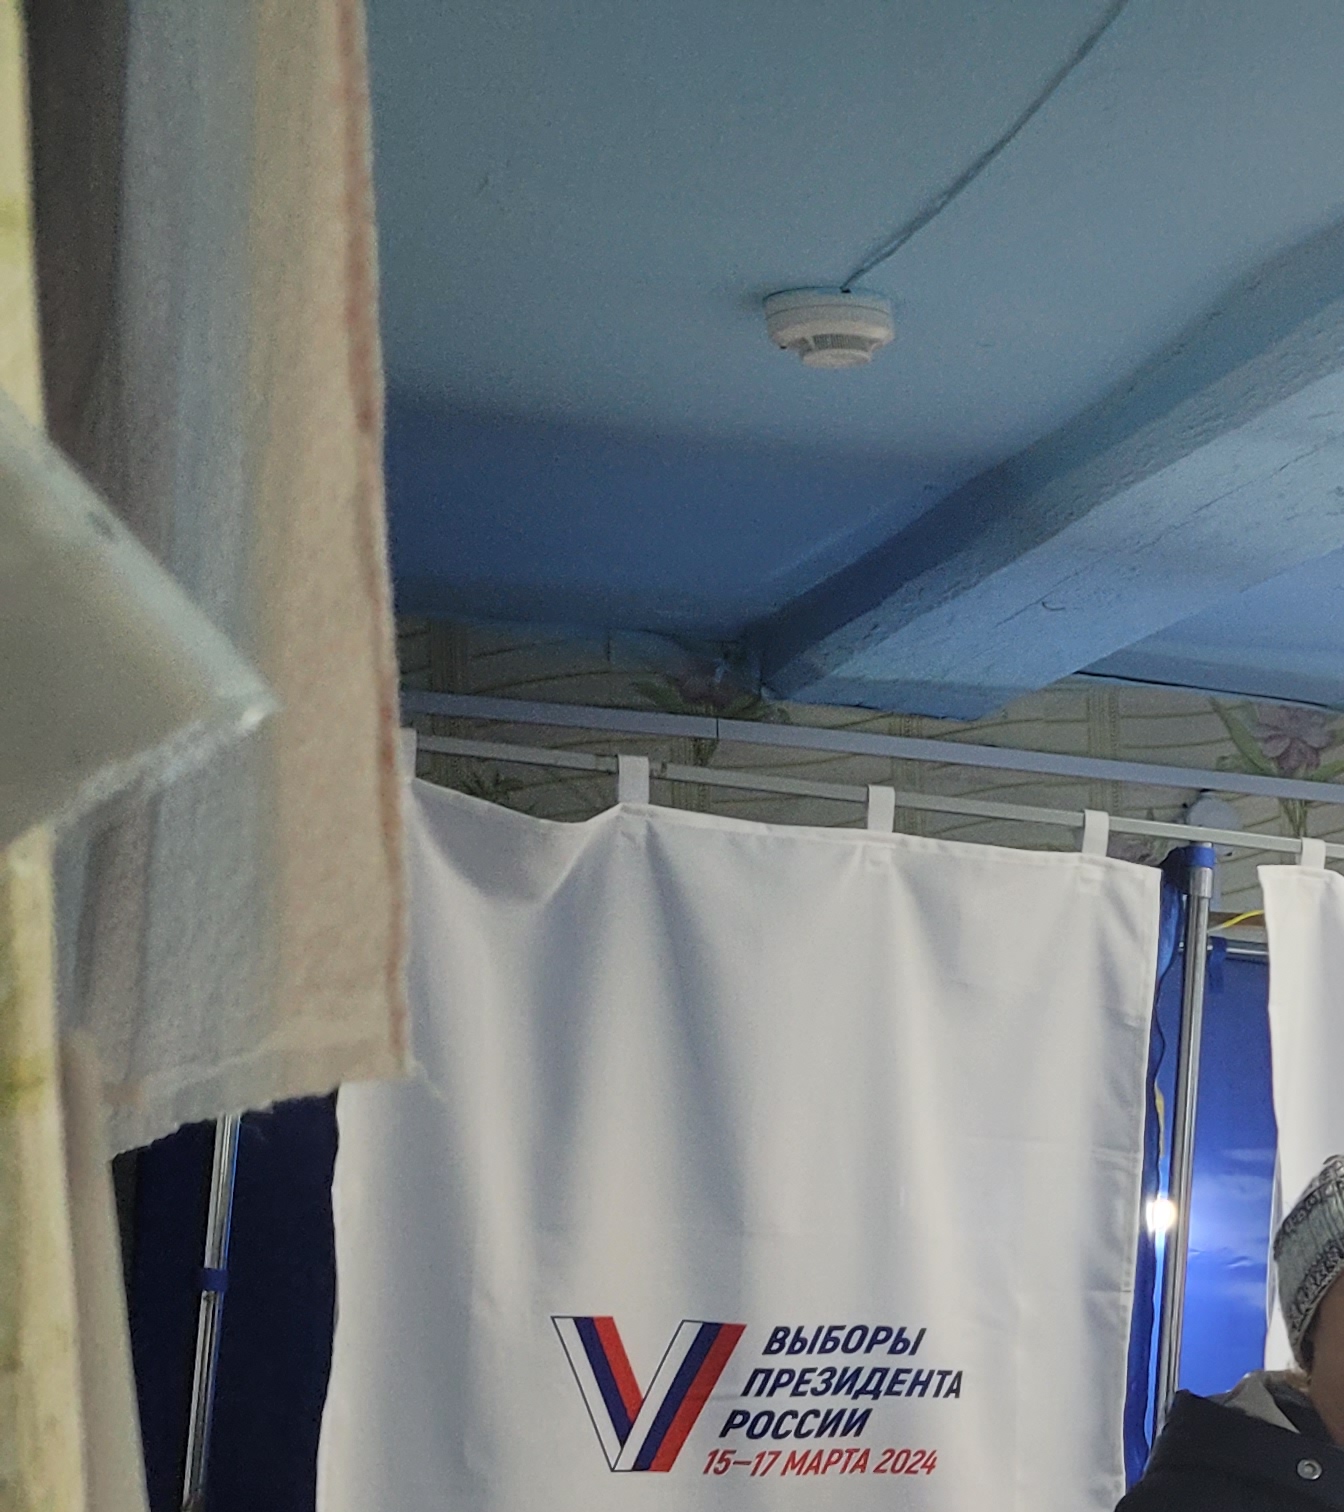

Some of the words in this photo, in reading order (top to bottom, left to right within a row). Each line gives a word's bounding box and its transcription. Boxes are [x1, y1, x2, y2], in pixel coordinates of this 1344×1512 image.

[762, 1325, 926, 1356] ВЫБОРЫ
[741, 1367, 963, 1400] ПРЕЗИДЕНТА
[718, 1408, 872, 1439] РОССИИ
[781, 1448, 872, 1476] МАРТА
[873, 1449, 937, 1475] 2024
